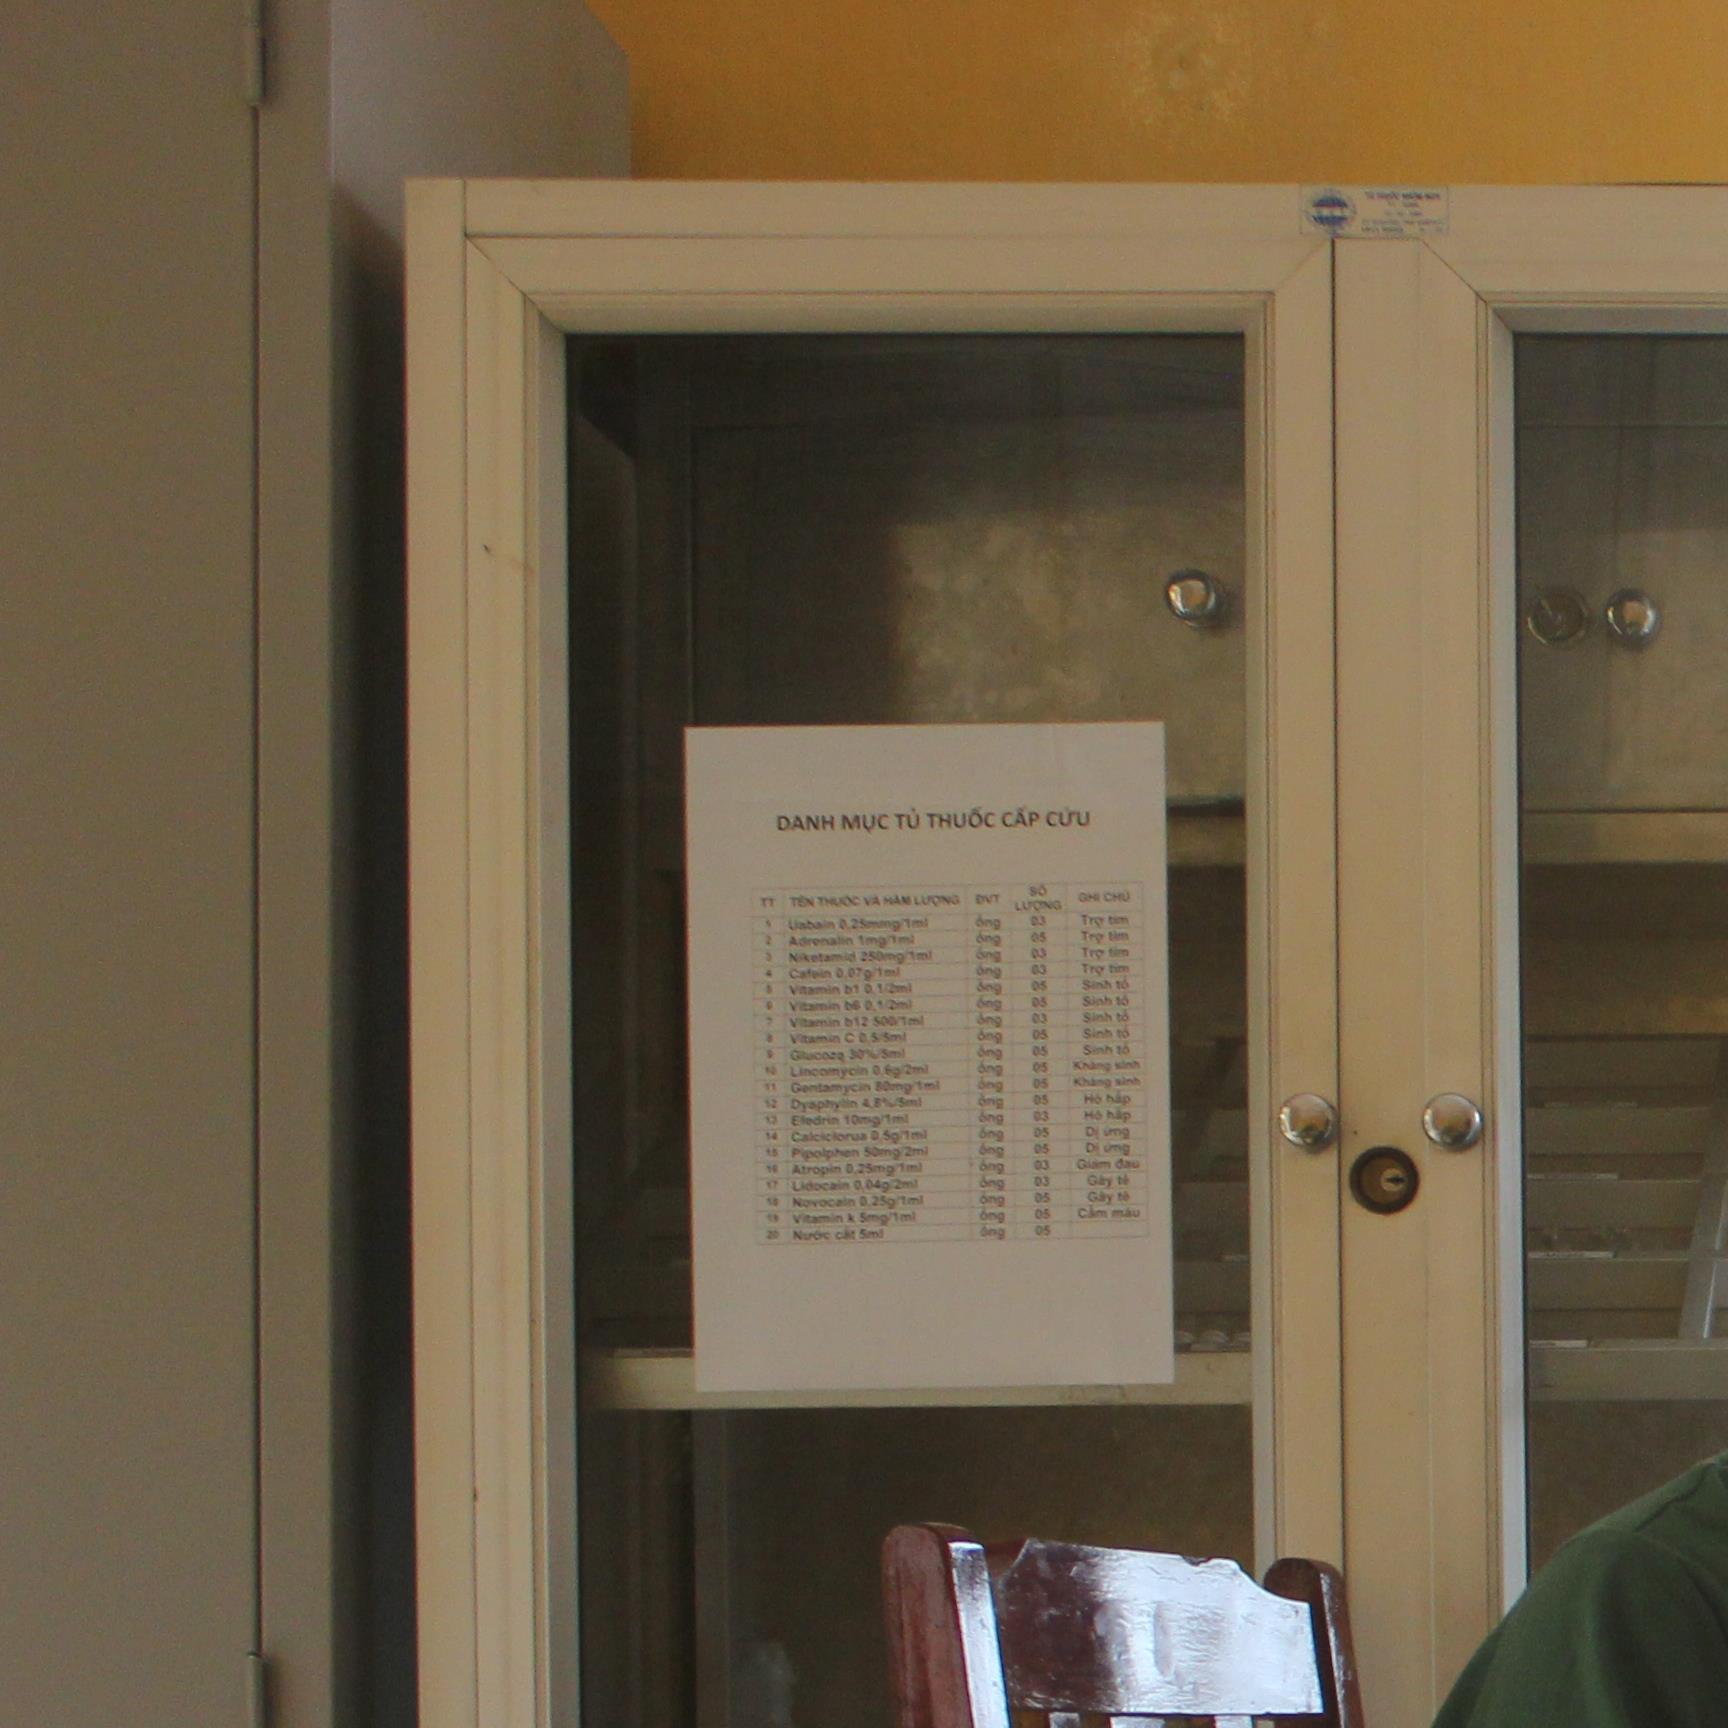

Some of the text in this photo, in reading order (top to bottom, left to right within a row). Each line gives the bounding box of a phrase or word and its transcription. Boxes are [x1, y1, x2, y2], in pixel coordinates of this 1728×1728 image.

[776, 806, 1091, 833] DANH MỤC TỦ THUỐC CẤP CỨU
[1030, 915, 1046, 926] 03
[1030, 931, 1046, 943] 05
[1030, 947, 1047, 959] 03
[1031, 964, 1047, 975] 03
[1031, 980, 1047, 992] 05
[1031, 996, 1047, 1008] 05
[1031, 1013, 1047, 1024] 03
[1031, 1029, 1048, 1041] 05
[1032, 1045, 1048, 1057] 05
[1032, 1062, 1048, 1073] 05
[1032, 1078, 1048, 1090] 05
[1032, 1094, 1048, 1106] 05
[1033, 1111, 1049, 1122] 03
[1033, 1127, 1049, 1138] 05
[1033, 1143, 1049, 1155] 05
[1033, 1160, 1049, 1171] 03
[1033, 1176, 1049, 1187] 03
[1034, 1192, 1050, 1204] 05
[1034, 1208, 1050, 1220] 05
[1034, 1225, 1051, 1236] 05
